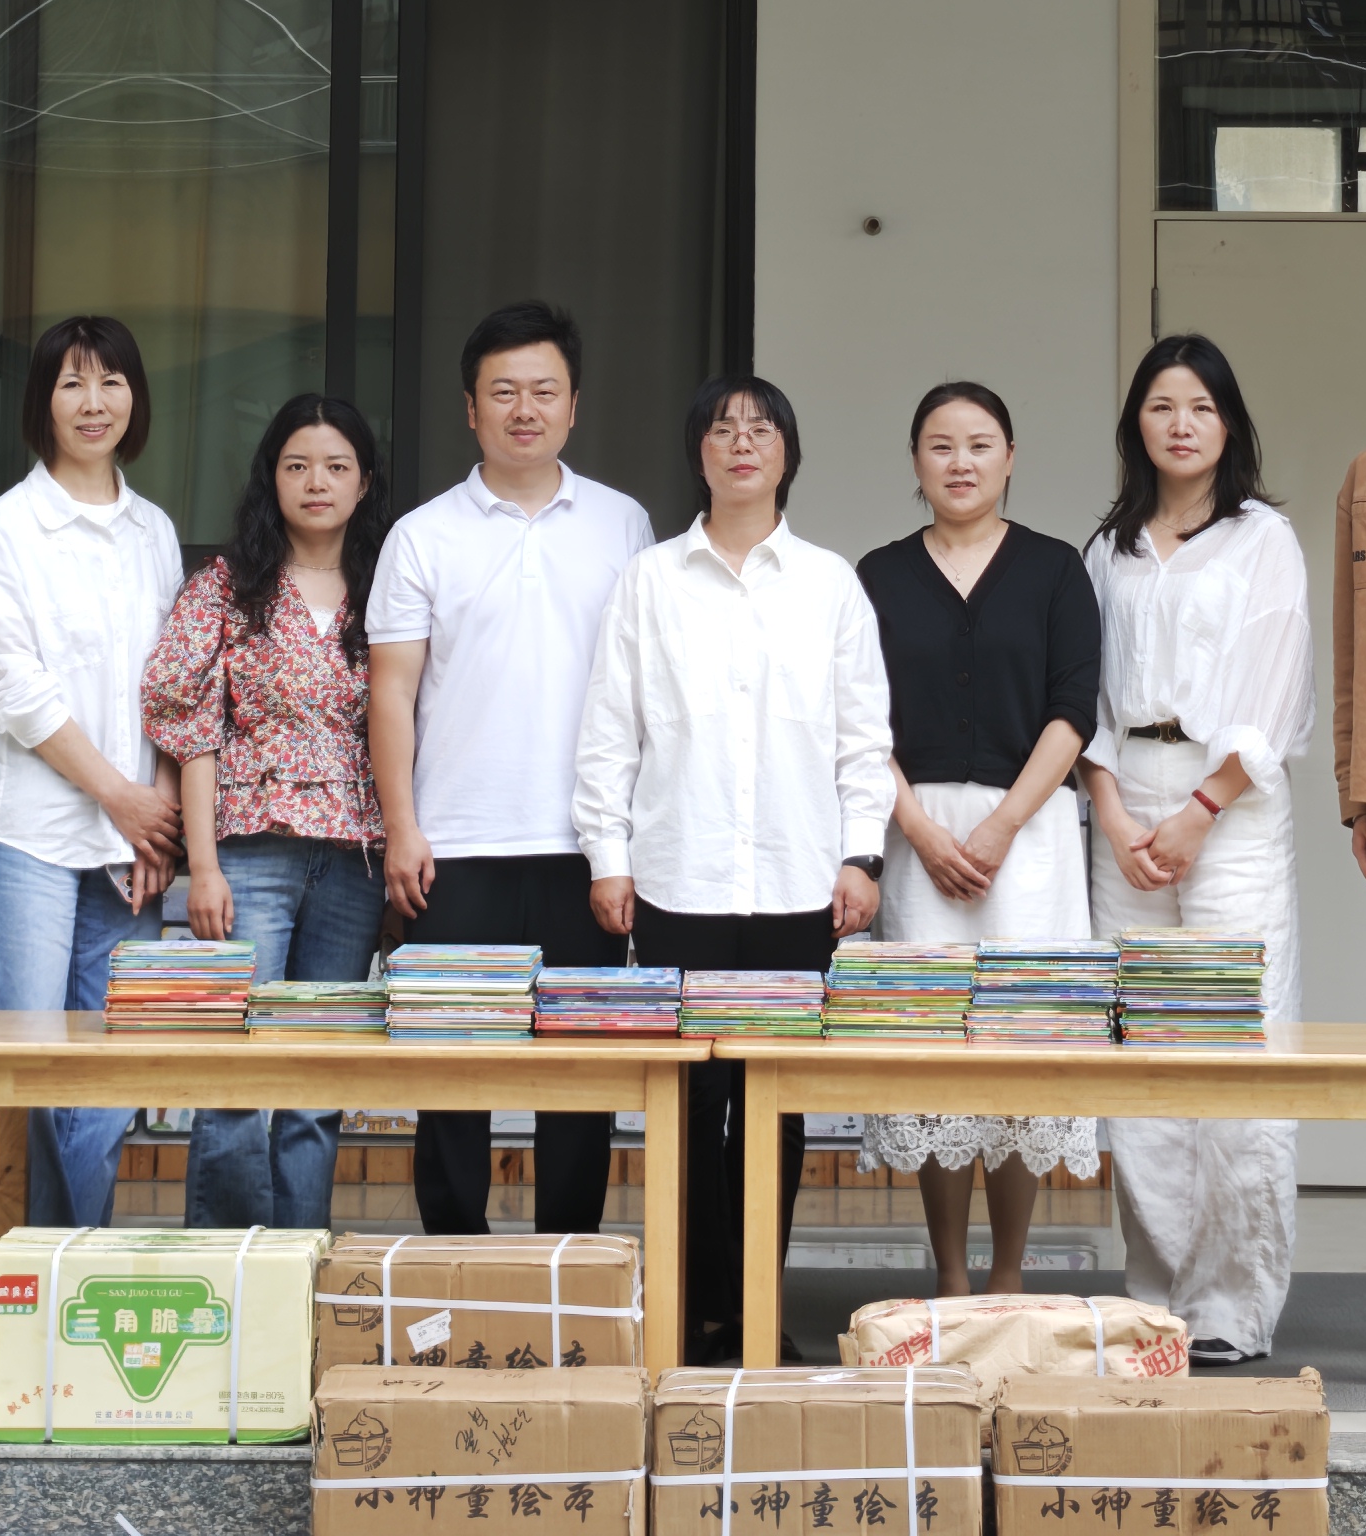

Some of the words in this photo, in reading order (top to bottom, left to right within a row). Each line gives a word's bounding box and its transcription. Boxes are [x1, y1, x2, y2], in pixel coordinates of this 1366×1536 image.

[108, 1288, 126, 1297] SAN
[128, 1288, 148, 1298] JIAO
[150, 1288, 167, 1297] CUI
[168, 1288, 183, 1297] GU
[74, 1308, 216, 1334] 三角脆骨
[700, 1480, 939, 1531] 小神童绘本
[1040, 1486, 1282, 1532] 小神童绘本
